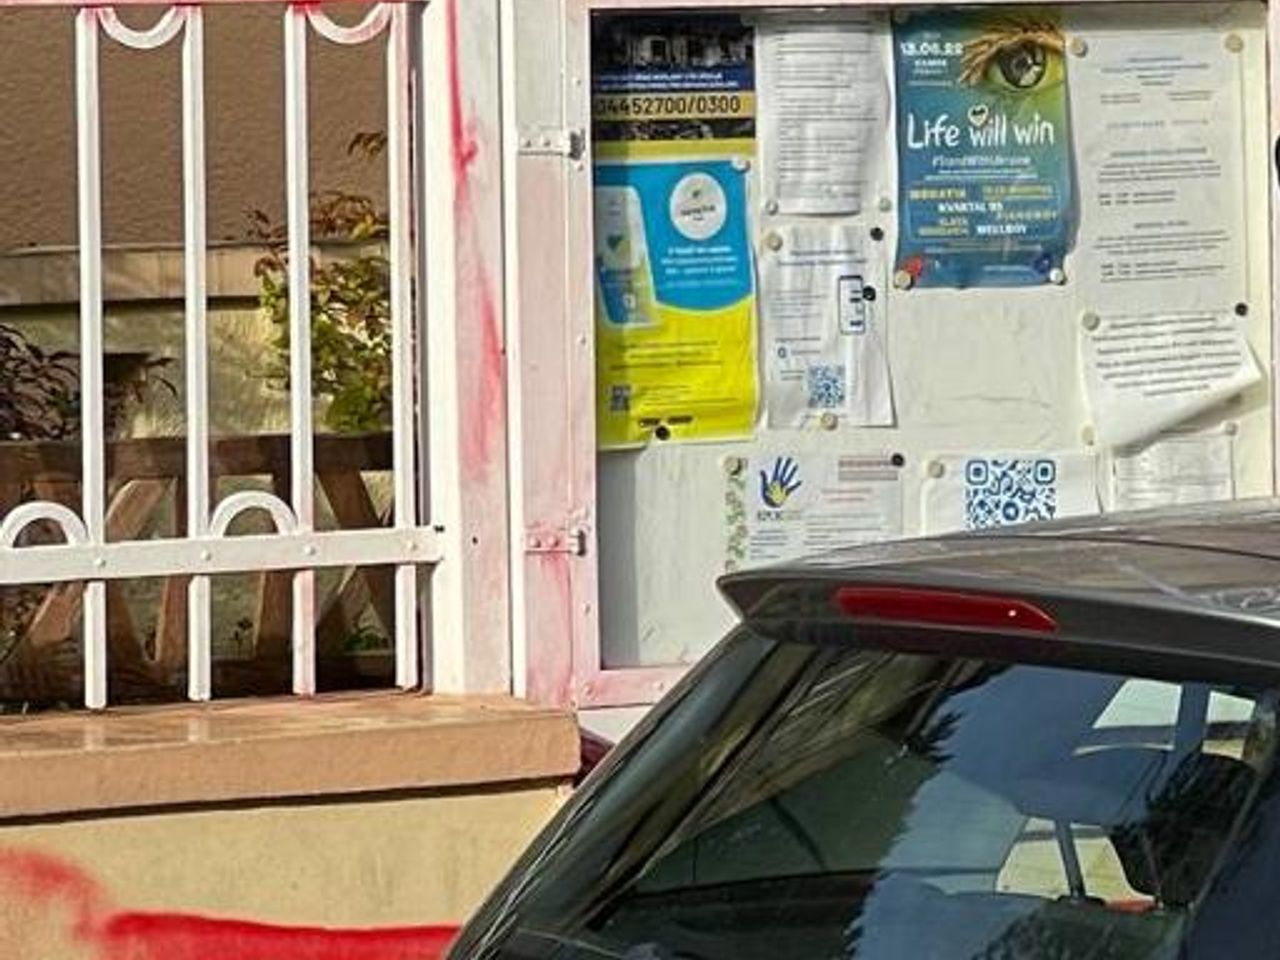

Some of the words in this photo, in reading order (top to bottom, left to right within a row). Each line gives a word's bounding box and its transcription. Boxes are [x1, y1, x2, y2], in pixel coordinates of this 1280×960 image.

[907, 113, 960, 149] Life
[969, 115, 1007, 147] will
[1013, 112, 1055, 146] win
